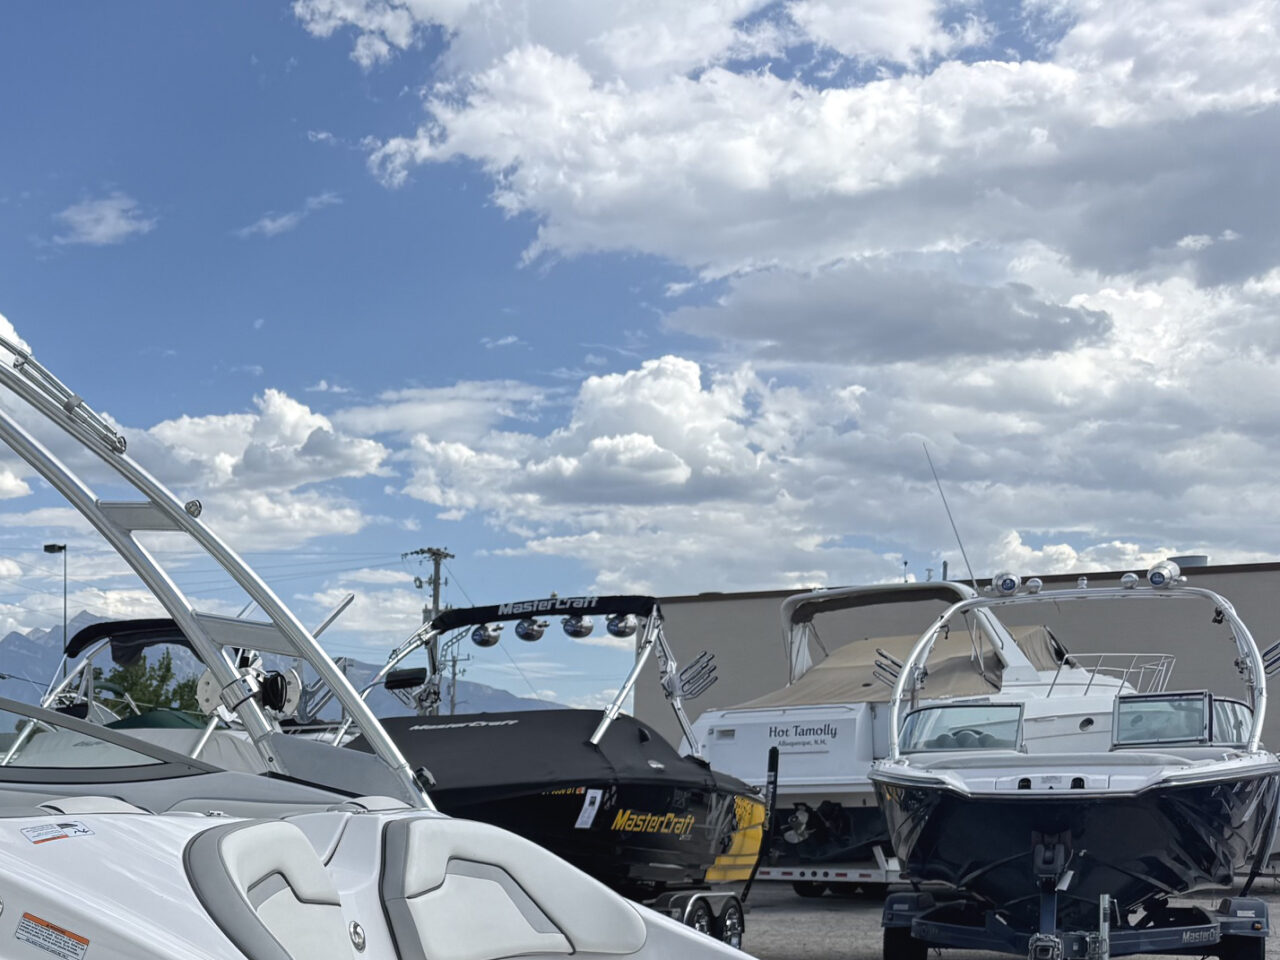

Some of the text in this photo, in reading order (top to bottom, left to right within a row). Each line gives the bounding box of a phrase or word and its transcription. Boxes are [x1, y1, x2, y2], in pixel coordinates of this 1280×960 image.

[498, 598, 599, 615] MasterCraft
[769, 724, 837, 739] Hot Tamolly
[611, 808, 695, 835] MasterCraft
